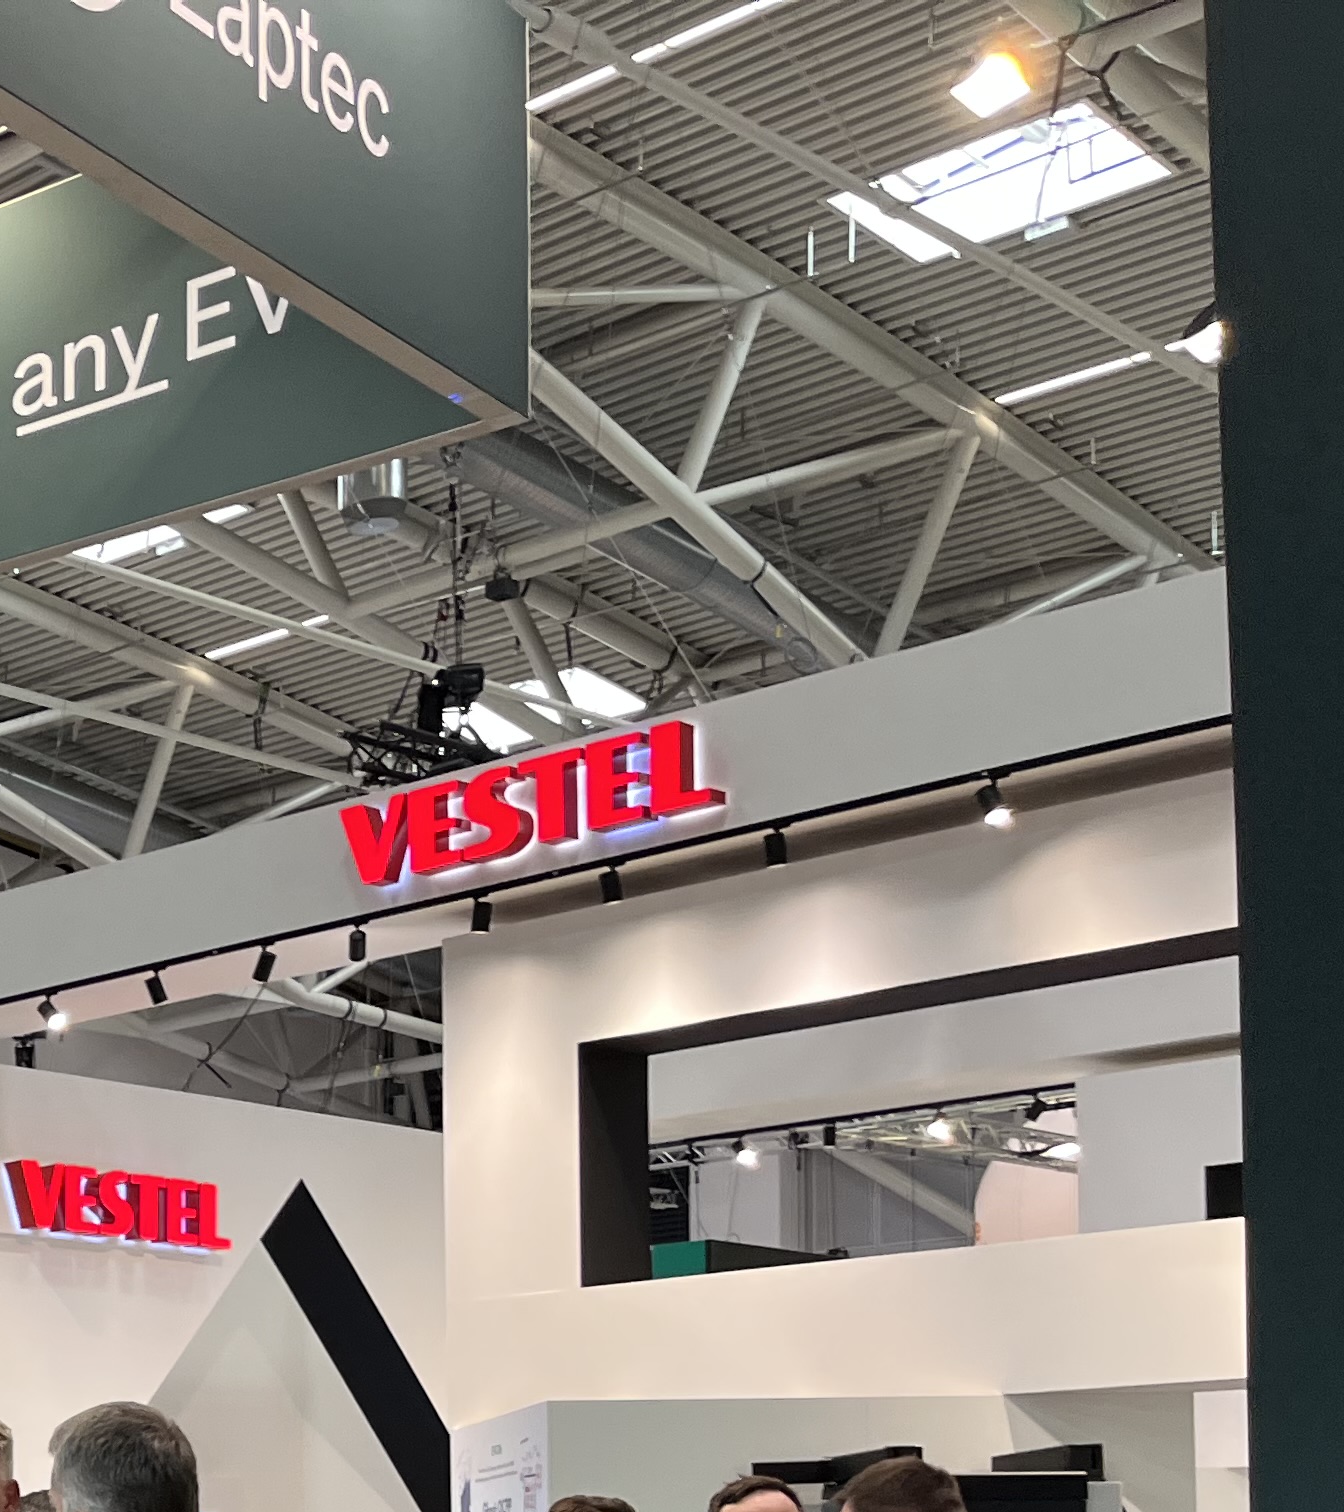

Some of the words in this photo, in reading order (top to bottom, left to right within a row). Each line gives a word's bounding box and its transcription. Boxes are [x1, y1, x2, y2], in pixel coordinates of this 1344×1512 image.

[12, 313, 168, 432] any
[339, 720, 724, 886] VESTEL
[4, 1158, 233, 1250] VESTEL
